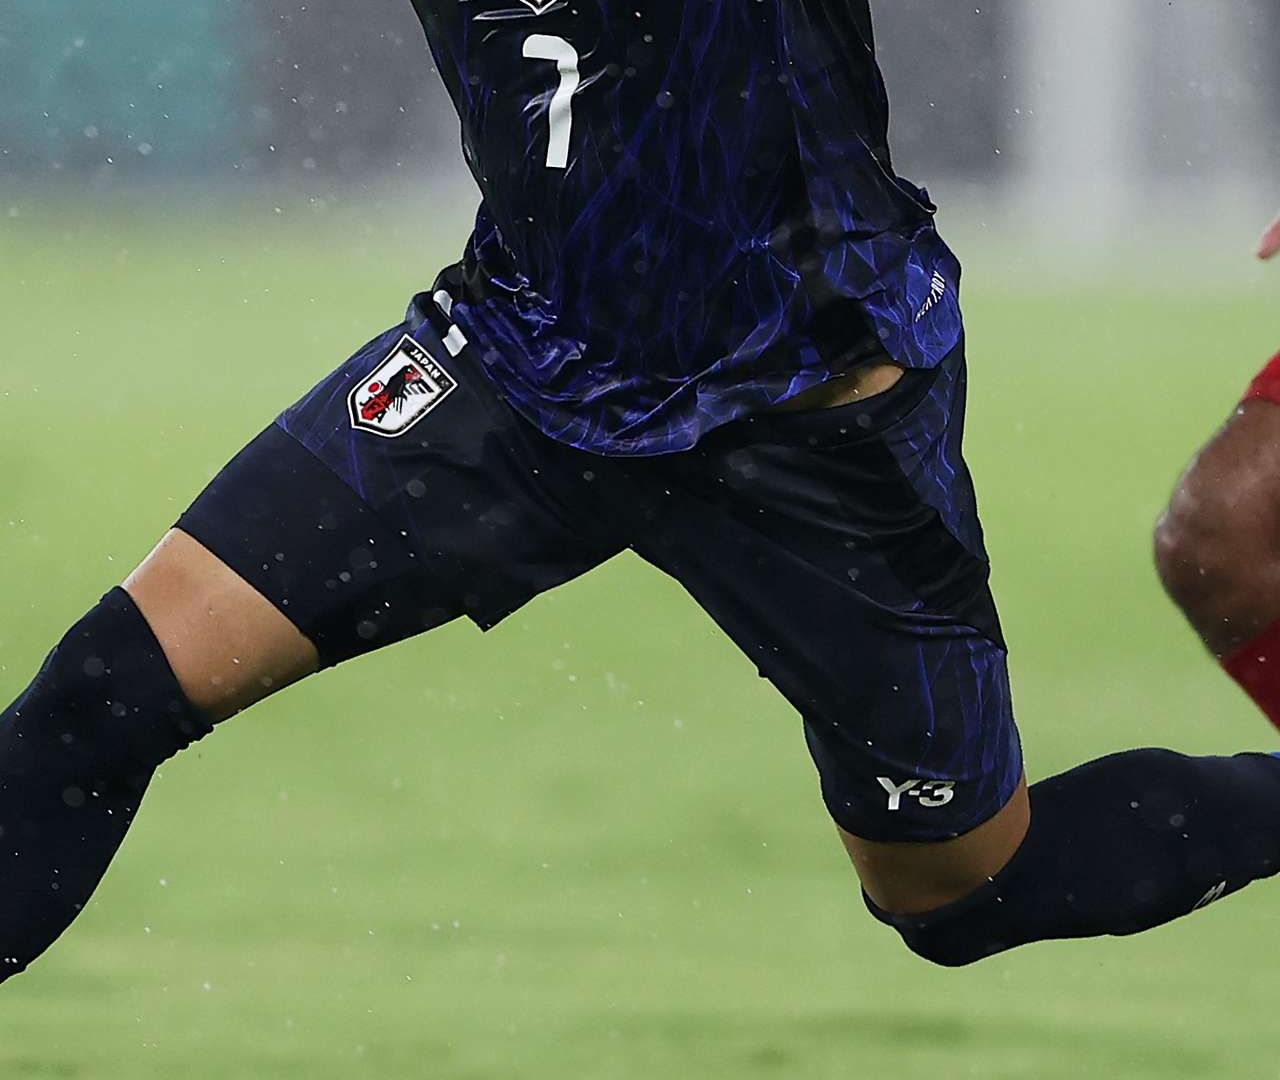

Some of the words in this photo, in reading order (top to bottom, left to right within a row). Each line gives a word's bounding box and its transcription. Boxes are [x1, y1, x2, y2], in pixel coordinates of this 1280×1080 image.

[522, 34, 580, 168] 7
[410, 348, 441, 379] JAPAN
[876, 777, 956, 811] Y-3
